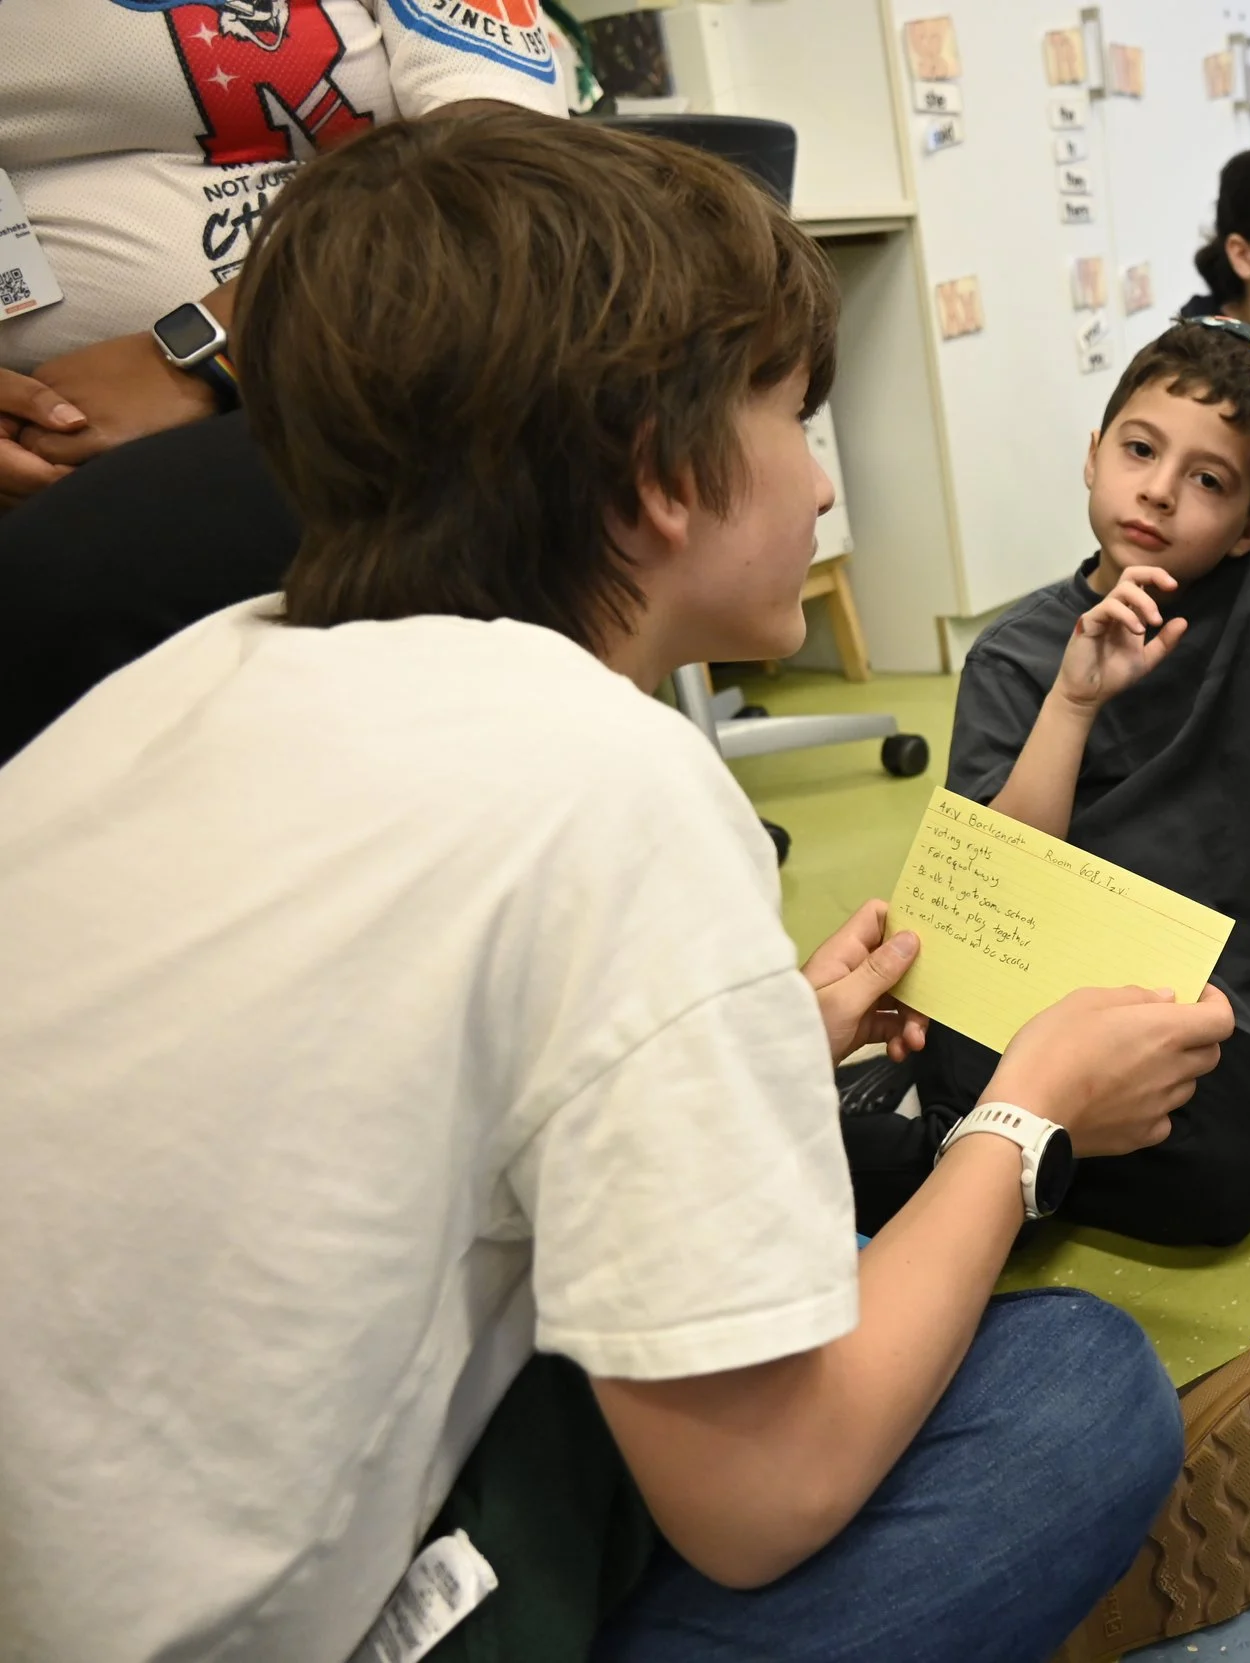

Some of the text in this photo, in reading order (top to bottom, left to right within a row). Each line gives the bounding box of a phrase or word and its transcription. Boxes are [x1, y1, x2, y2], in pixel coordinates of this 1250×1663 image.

[433, 0, 513, 46] SINCE
[203, 175, 250, 202] NOT
[939, 801, 961, 820] Aviv
[1044, 850, 1072, 870] Room
[966, 912, 986, 933] play
